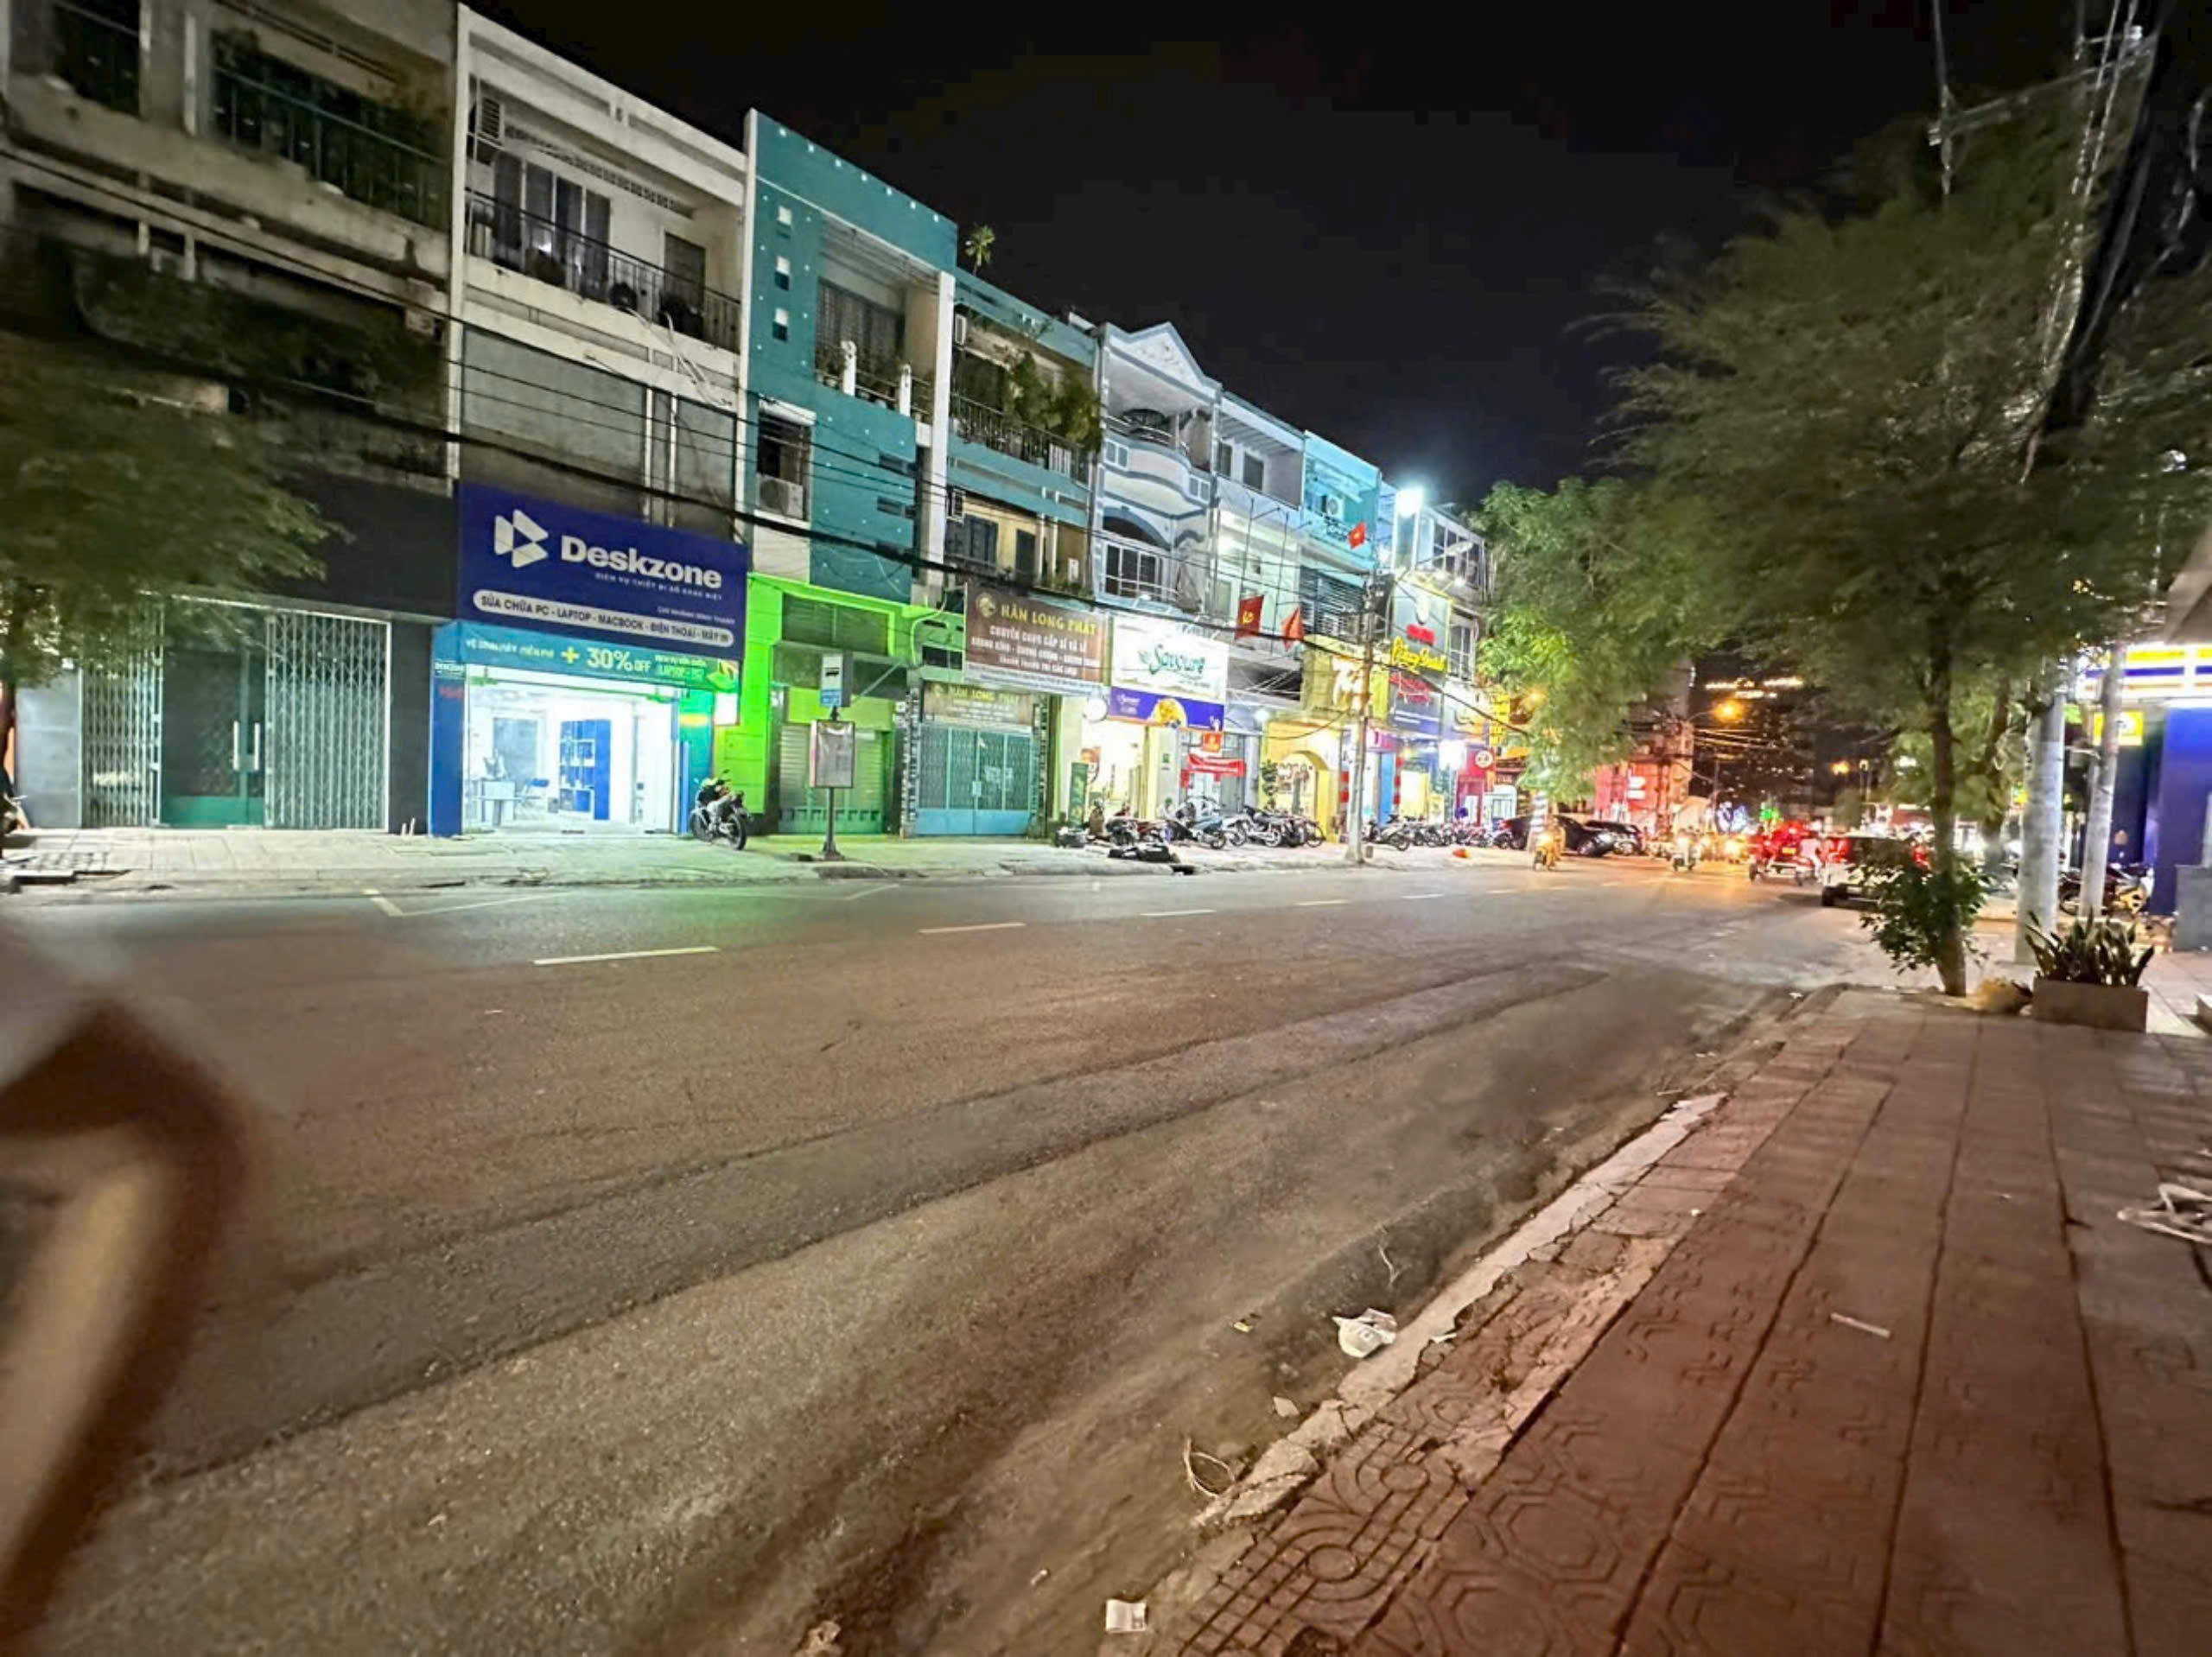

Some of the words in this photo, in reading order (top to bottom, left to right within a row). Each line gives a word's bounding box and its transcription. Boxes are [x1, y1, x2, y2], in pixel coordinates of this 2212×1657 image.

[561, 535, 722, 589] Deskzone
[480, 594, 501, 609] SỬA
[504, 599, 533, 613] CHỮA
[536, 604, 550, 617] PC
[556, 607, 592, 625] LAPTOP
[598, 614, 644, 631] MACBOOK
[1032, 612, 1065, 631] LONG
[587, 647, 634, 672] 30%
